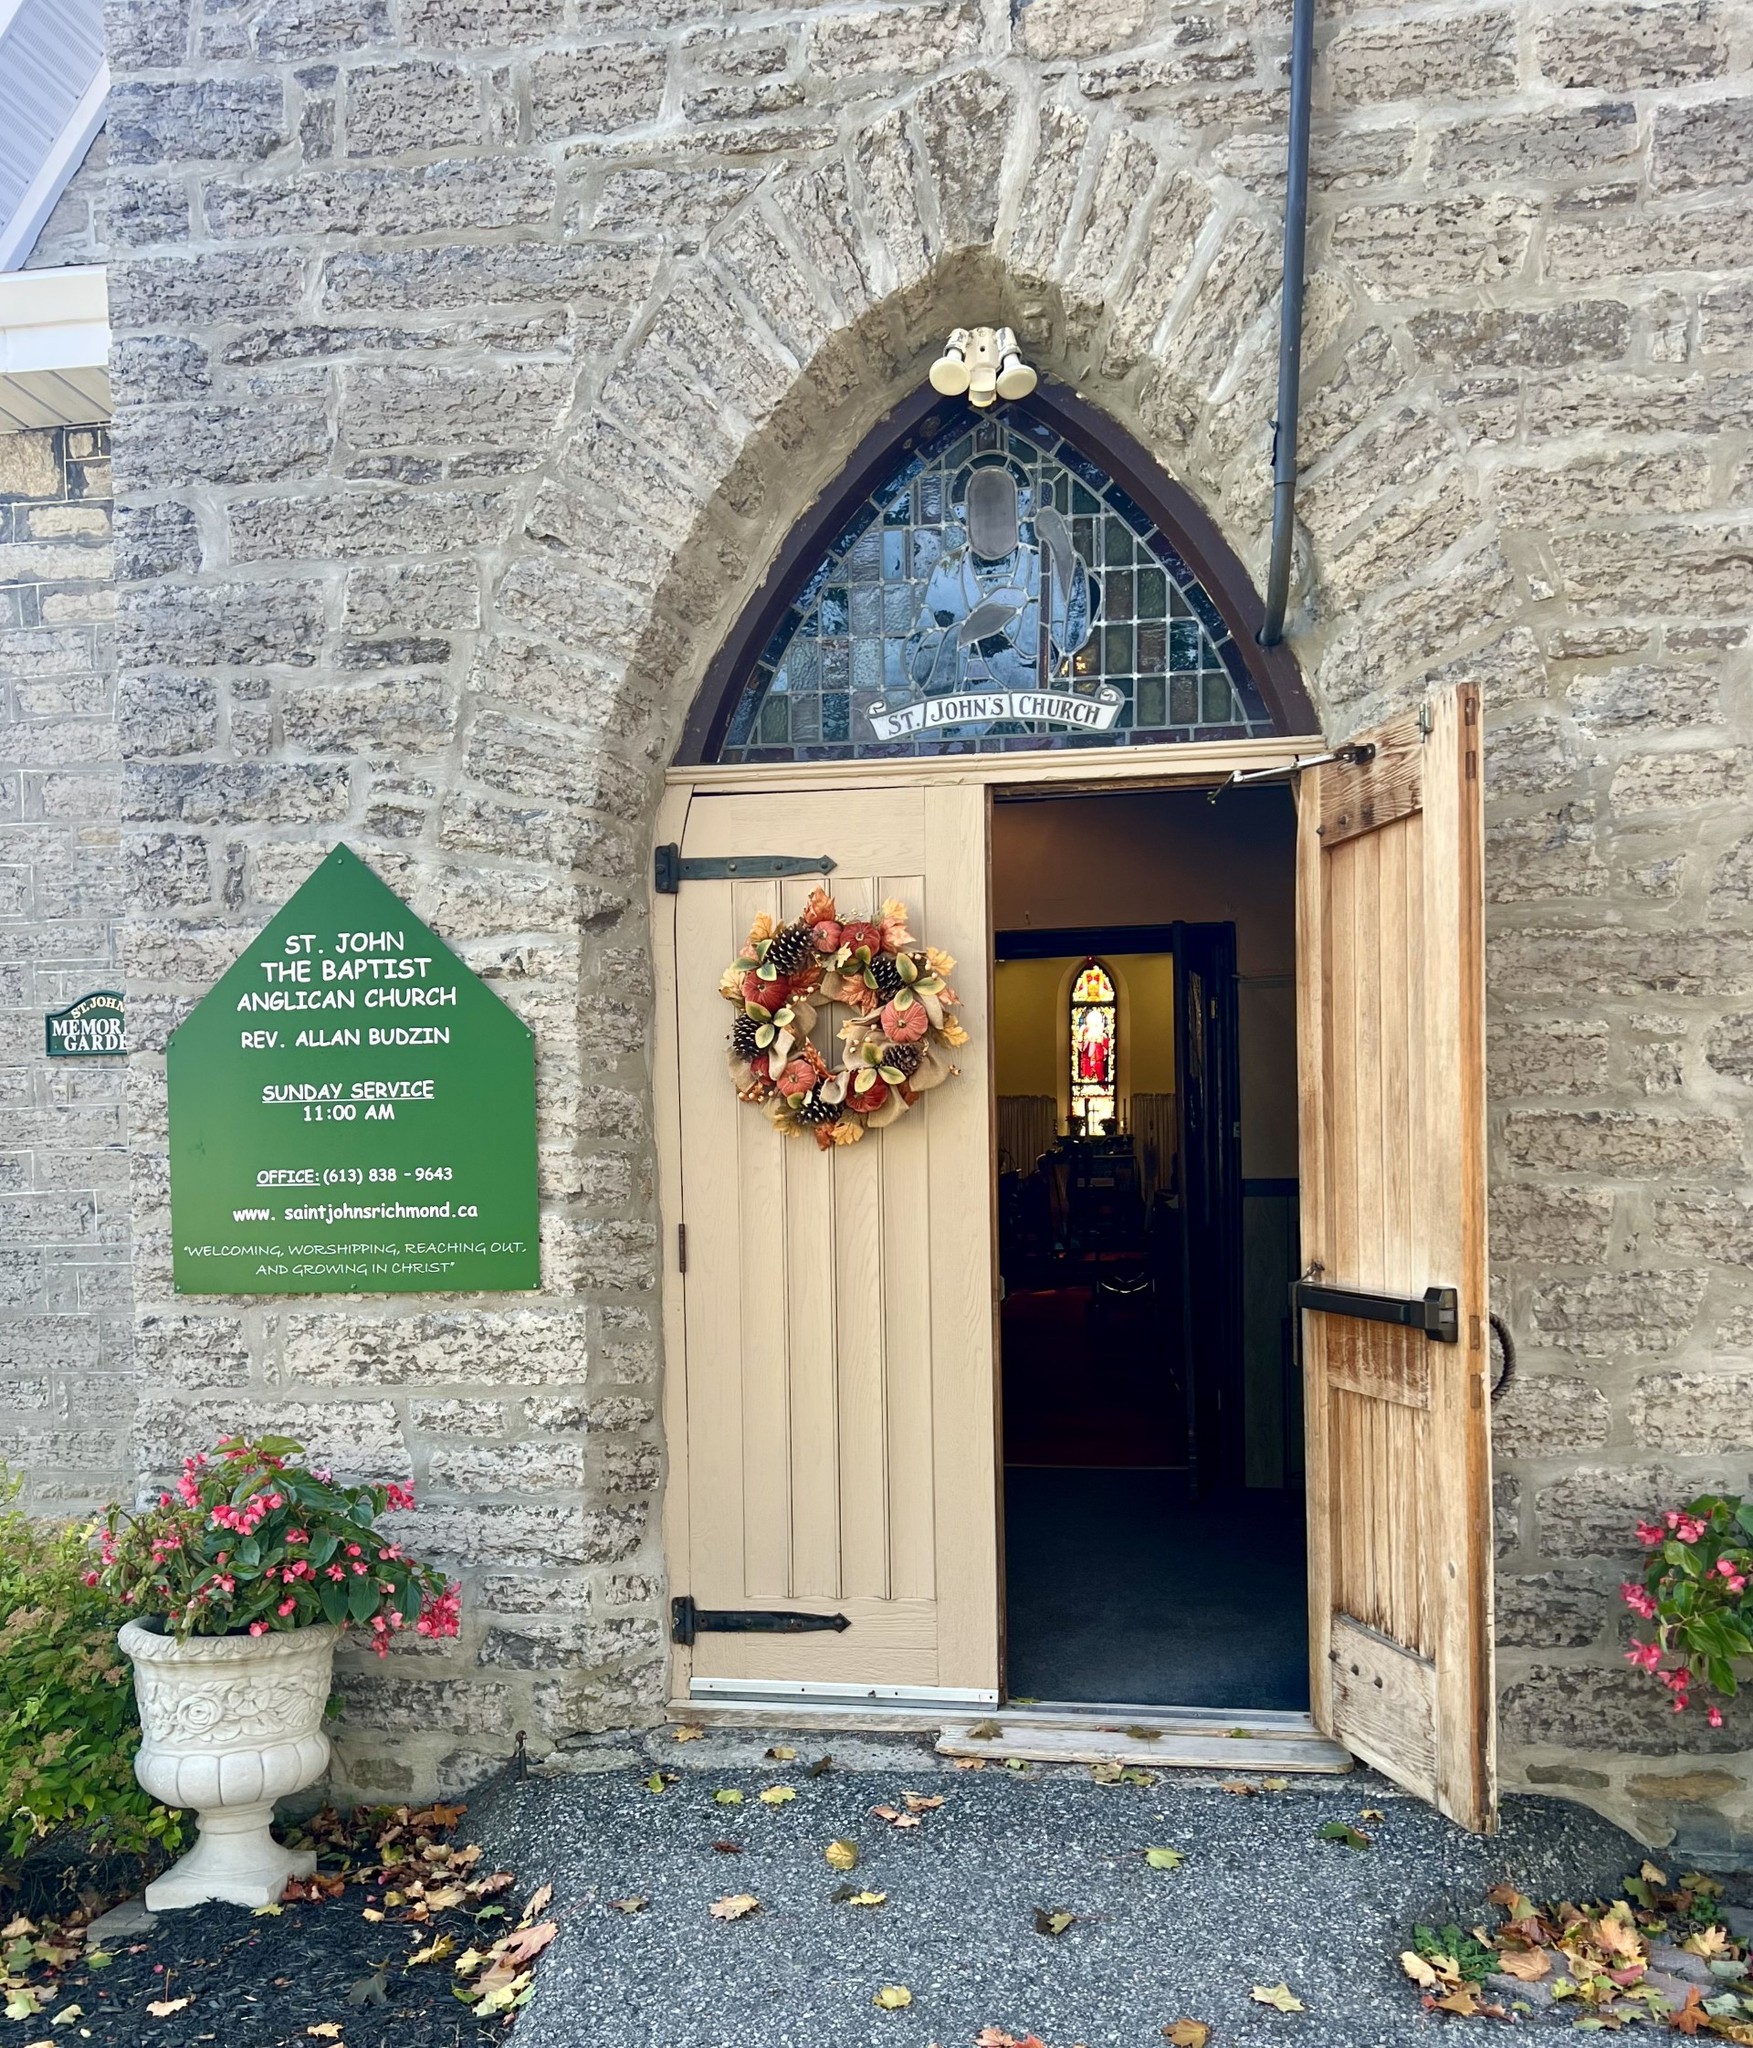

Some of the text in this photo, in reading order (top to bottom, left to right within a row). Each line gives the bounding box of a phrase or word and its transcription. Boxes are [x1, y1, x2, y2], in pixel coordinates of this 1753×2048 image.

[888, 695, 1101, 736] ST. JOHN'S CHURCH
[285, 931, 405, 955] ST. JOHN
[260, 957, 433, 983] THE BAPTIST
[236, 986, 457, 1012] ANGLICAN CHURCH
[70, 1002, 90, 1019] ST.
[240, 1026, 450, 1049] REV. ALLAN BUDZIN
[262, 1080, 435, 1102] SUNDAY SERVICE
[301, 1104, 396, 1122] 11:00 AM
[255, 1169, 320, 1186] OFFICE:
[322, 1168, 364, 1186] (613)
[368, 1167, 398, 1183] 838
[232, 1201, 479, 1225] www. saintjohnsrichmond.ca
[287, 1243, 401, 1257] WORSHIPPING,
[404, 1242, 487, 1256] REACHING
[255, 1261, 455, 1278] AND GROWING IN CHRIST"
